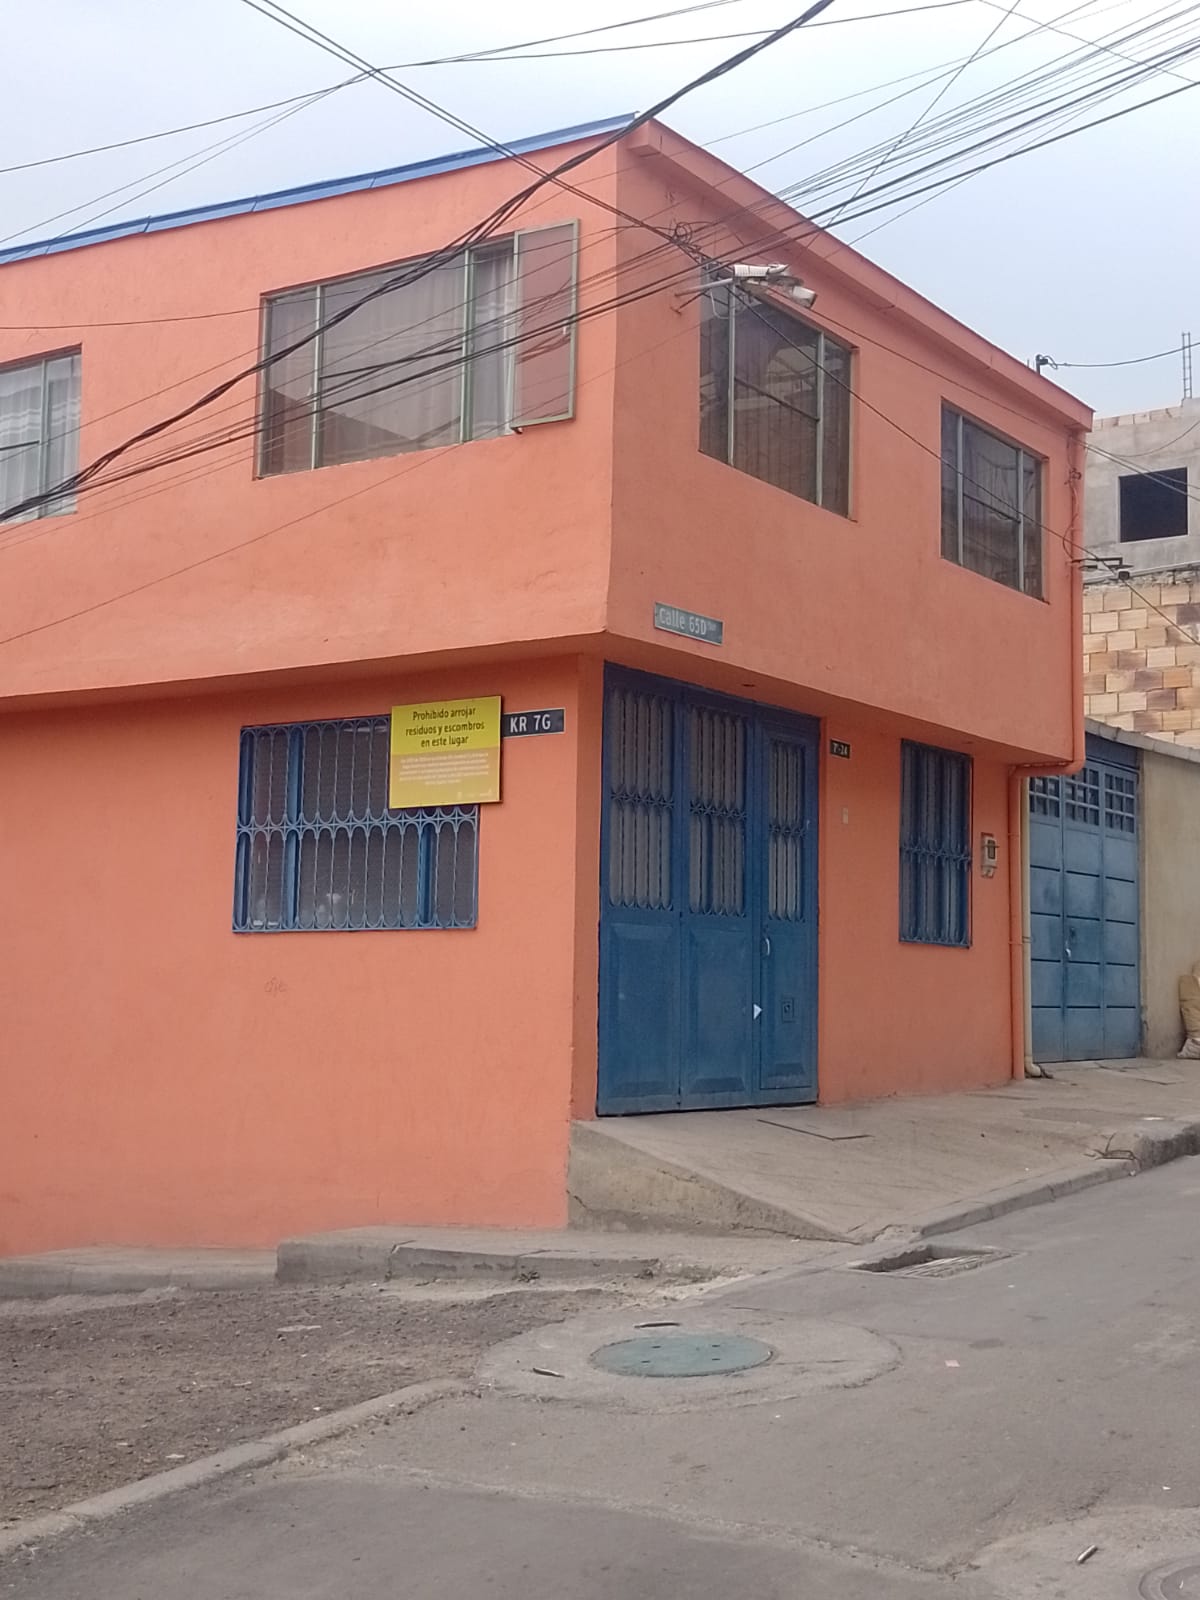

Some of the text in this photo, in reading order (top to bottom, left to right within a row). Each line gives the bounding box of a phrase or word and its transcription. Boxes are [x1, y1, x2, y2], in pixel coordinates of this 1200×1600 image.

[659, 607, 686, 630] Calle
[412, 706, 476, 721] Prohibido arrojar
[405, 721, 485, 736] residuos y escombros
[510, 714, 551, 733] KR 7G
[420, 735, 469, 748] en este lugar
